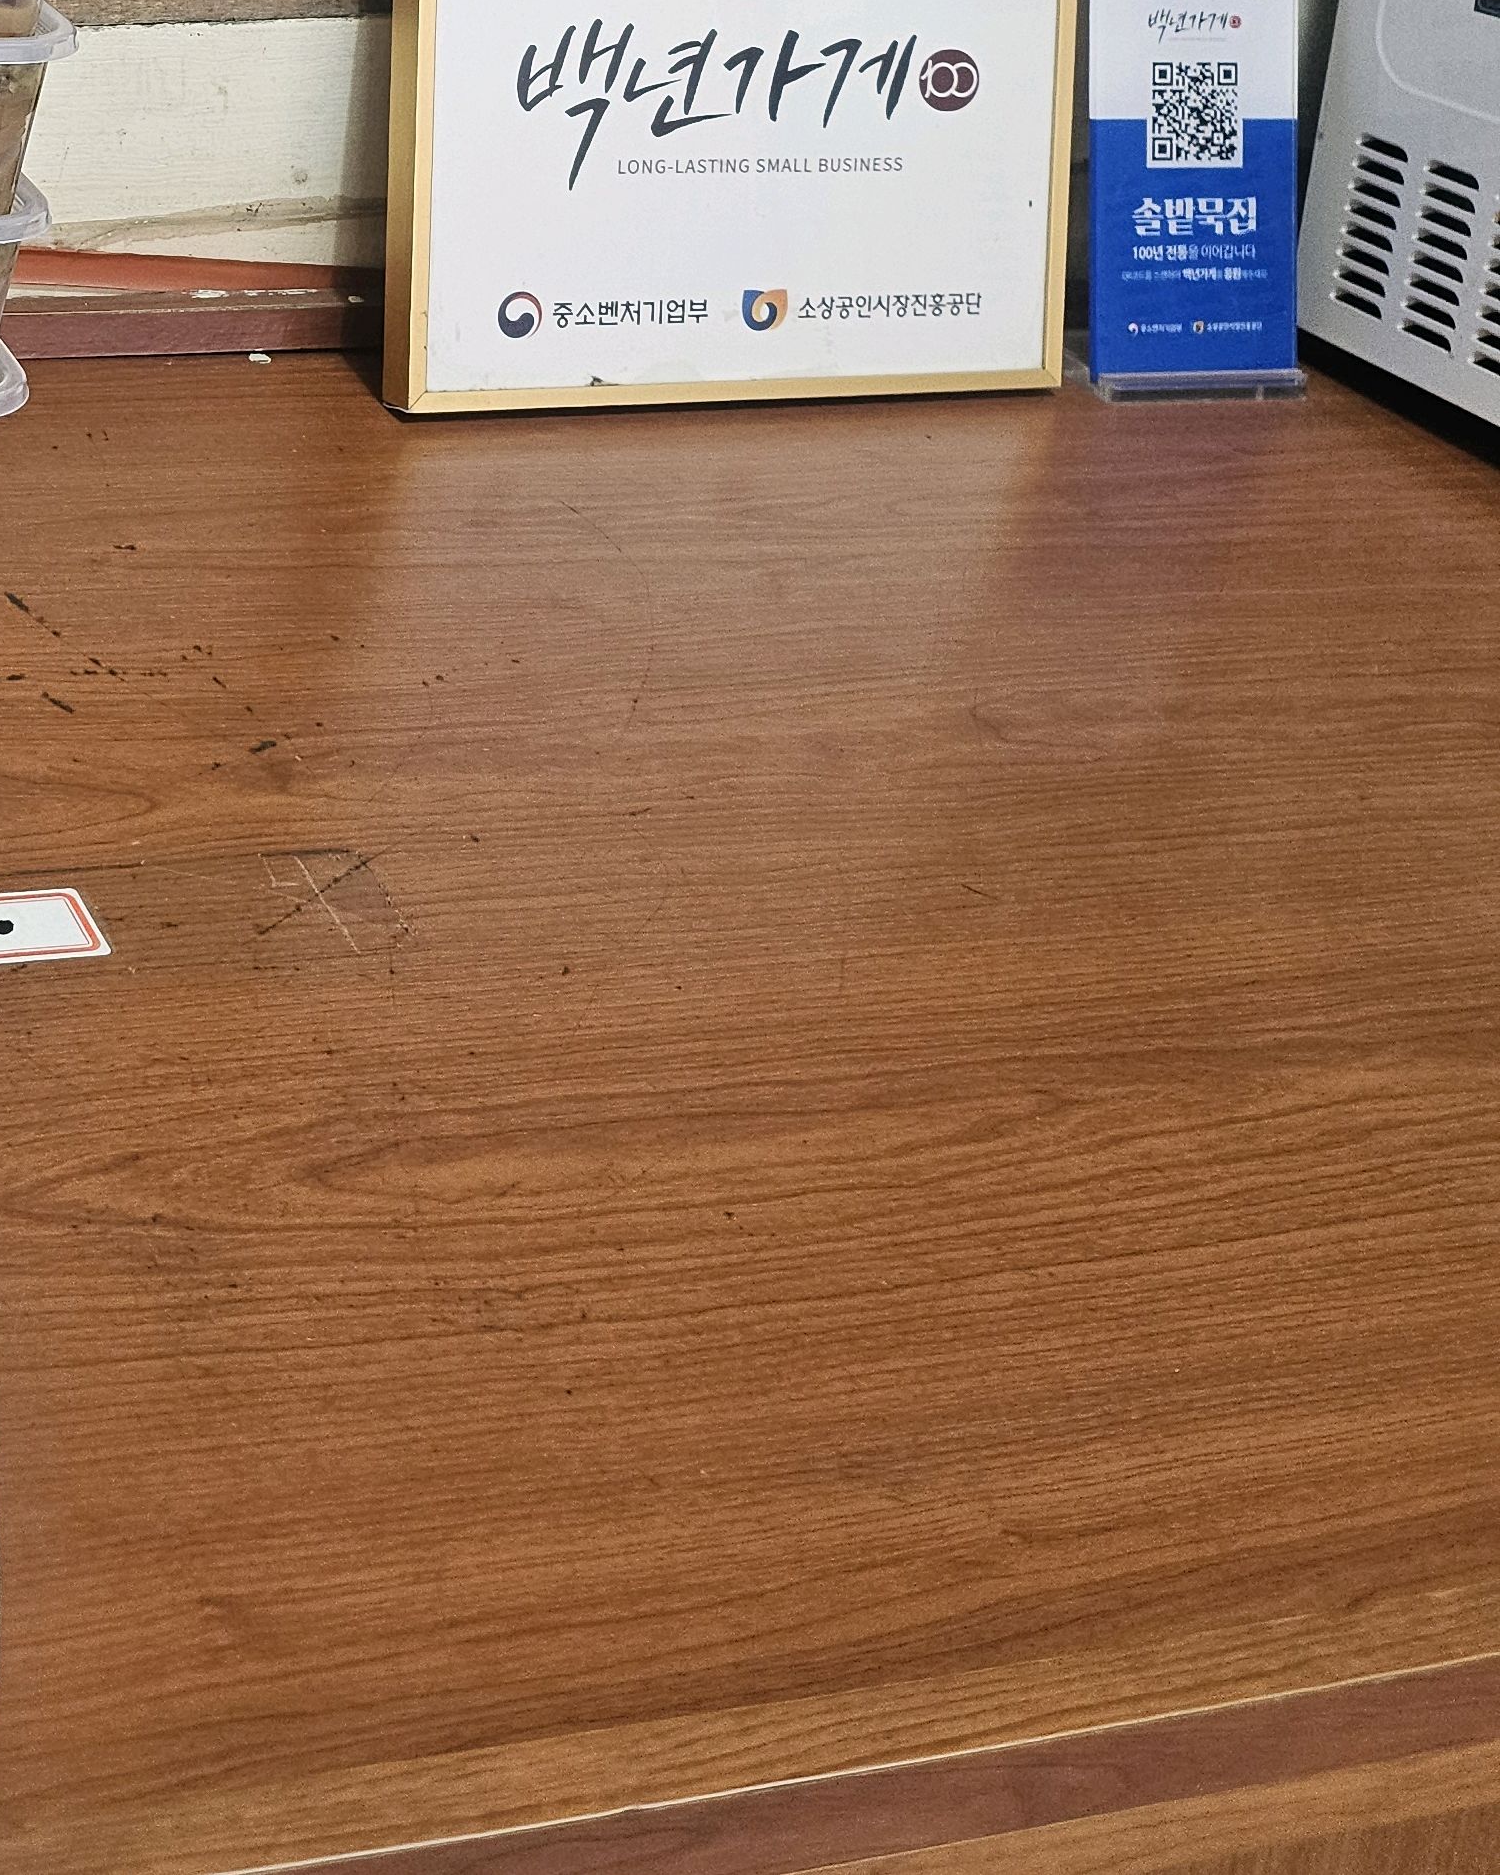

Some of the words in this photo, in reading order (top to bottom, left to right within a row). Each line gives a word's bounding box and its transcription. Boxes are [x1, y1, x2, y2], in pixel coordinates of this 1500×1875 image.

[1148, 8, 1229, 44] 백년가게
[516, 19, 917, 191] 백년가게
[617, 158, 751, 175] LONG-LASTING
[756, 157, 812, 174] SMALL
[818, 156, 903, 173] BUSINESS
[1132, 196, 1257, 237] 솔밭묵집
[1133, 245, 1164, 261] 100년
[552, 299, 710, 330] 중소벤처기업부
[798, 291, 982, 321] 소상공인시장진흥공단
